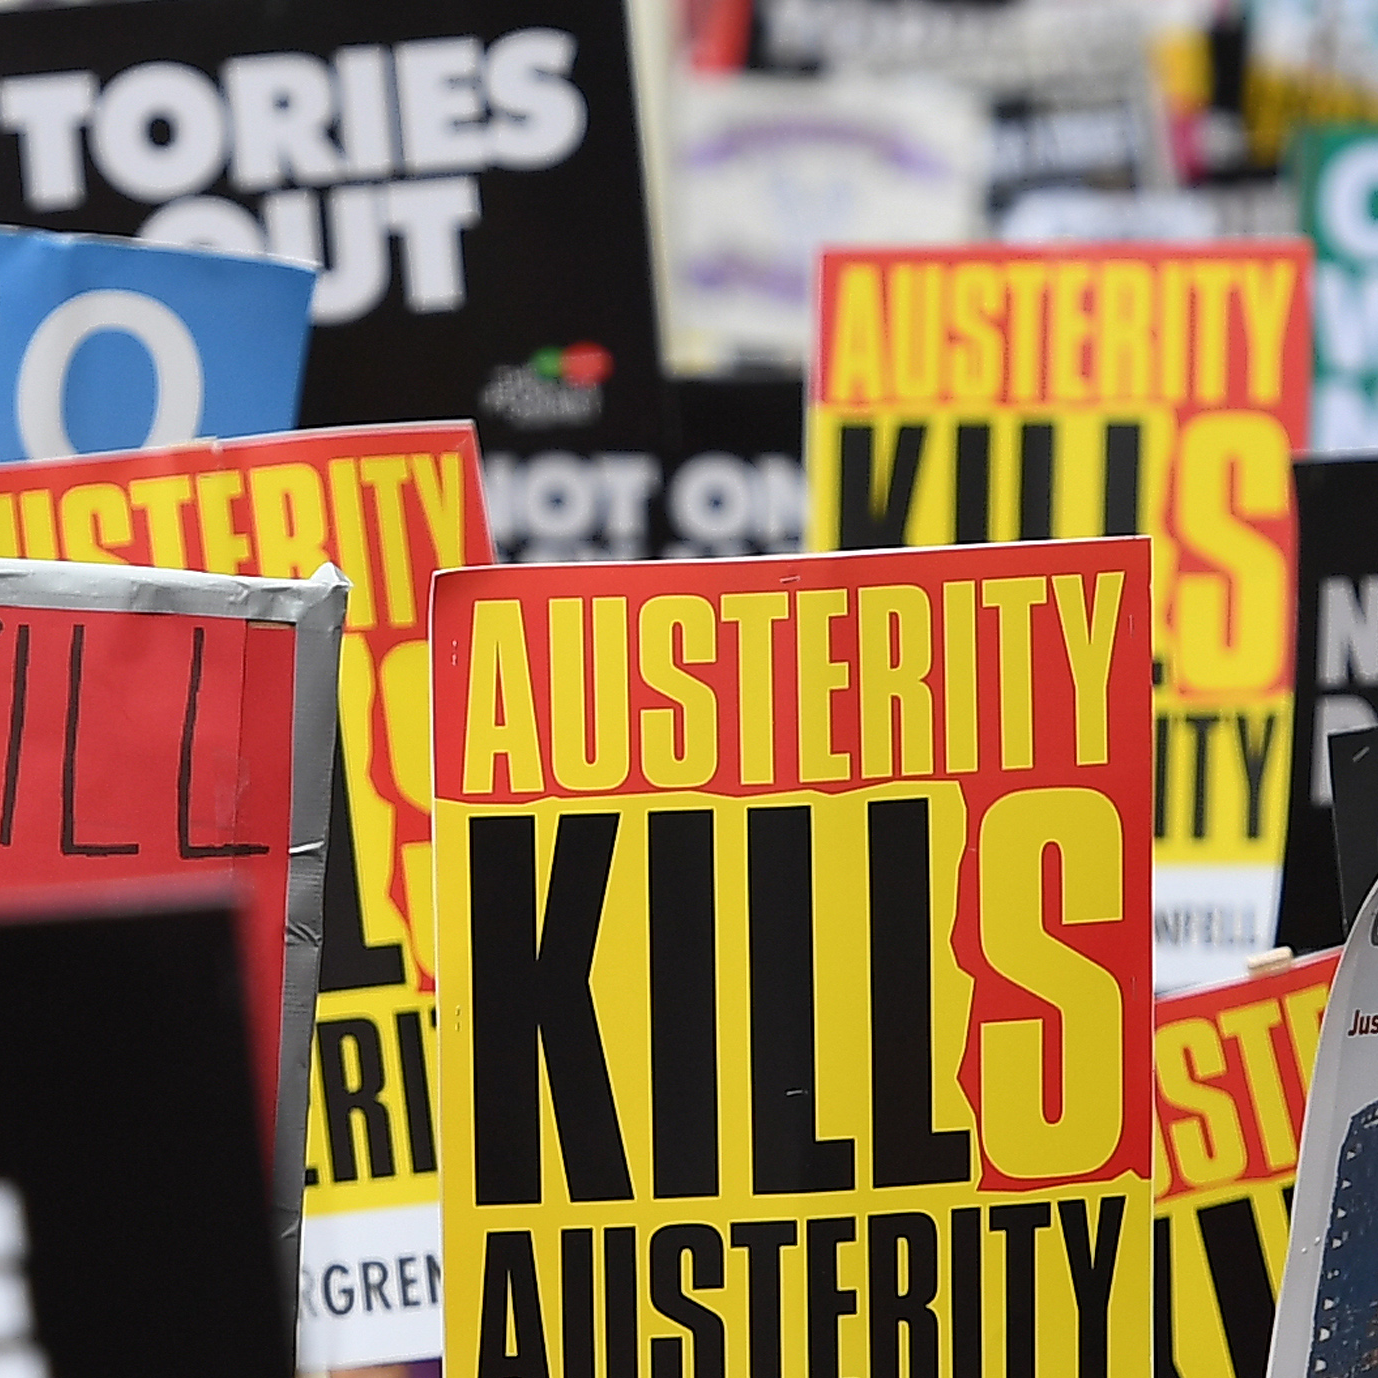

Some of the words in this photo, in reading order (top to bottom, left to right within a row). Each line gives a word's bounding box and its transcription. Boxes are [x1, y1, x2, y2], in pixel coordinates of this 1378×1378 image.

[830, 260, 1298, 408] AUSTERITY
[462, 571, 1125, 795] AUSTERITY
[468, 786, 1124, 1206] KILLS
